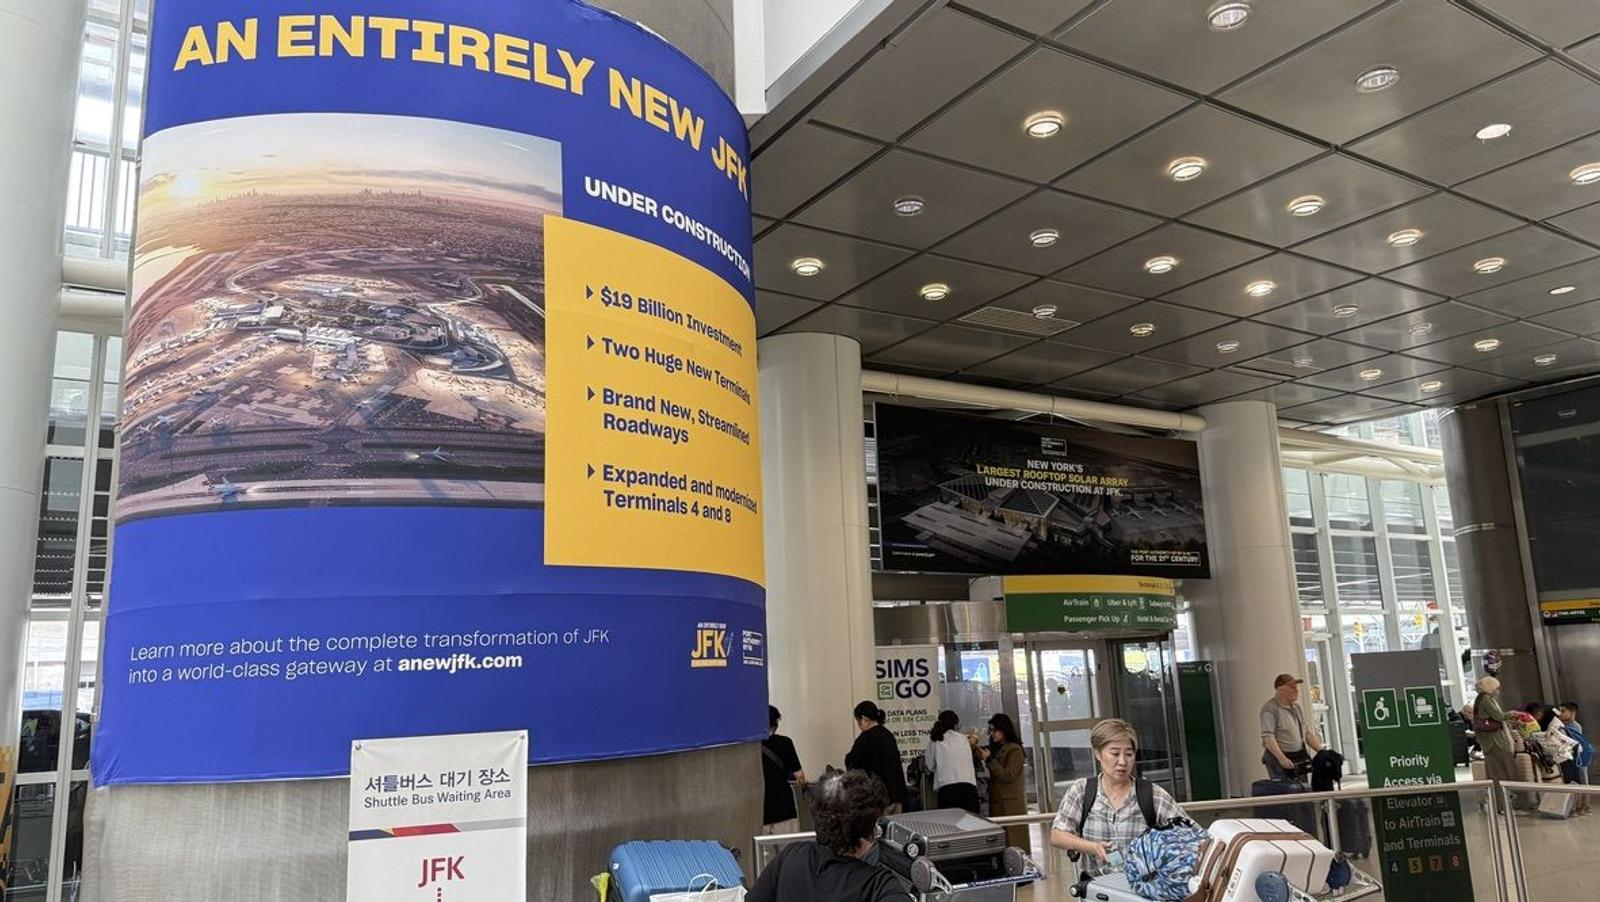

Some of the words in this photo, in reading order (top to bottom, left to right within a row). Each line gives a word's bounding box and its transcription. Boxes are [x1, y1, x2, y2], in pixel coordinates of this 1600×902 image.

[173, 17, 258, 71] AN
[277, 14, 595, 96] ENTIRELY
[608, 67, 705, 151] NEW
[711, 135, 748, 202] JFK
[584, 176, 659, 217] UNDER
[661, 205, 751, 282] CONSTRUCTION
[600, 285, 633, 309] $19
[638, 297, 684, 326] Billion
[686, 313, 743, 357] Investment
[602, 337, 640, 360] Two
[645, 347, 683, 373] Huge
[687, 358, 714, 382] New
[714, 370, 751, 405] Terminals
[603, 388, 656, 412] Brand
[660, 398, 696, 424] New,
[603, 412, 689, 445] Roadways
[976, 463, 1022, 479] LARGEST
[1023, 469, 1067, 482] ROOFTOP
[1068, 473, 1098, 485] SOLAR
[1099, 476, 1129, 487] ARRAY
[1026, 459, 1049, 470] NEW
[1050, 462, 1084, 473] YORK'S
[603, 463, 687, 491] Expanded
[691, 480, 713, 496] and
[984, 477, 1020, 489] UNDER
[1020, 480, 1092, 495] CONSTRUCTION
[1093, 486, 1105, 495] AT
[1106, 488, 1124, 497] JFK.
[603, 489, 688, 515] Terminals
[690, 500, 699, 516] 4
[702, 505, 723, 521] and
[724, 508, 732, 523] 8
[1130, 553, 1145, 562] FOR
[1145, 554, 1157, 562] THE
[1170, 555, 1199, 563] CENTURY
[1063, 598, 1090, 606] AirTrain
[1063, 615, 1098, 624] Passenger
[130, 643, 175, 662] Learn
[179, 641, 224, 658] more
[229, 637, 283, 655] about
[289, 635, 320, 652] the
[326, 632, 418, 655] complete
[424, 629, 558, 649] transformation
[563, 628, 579, 645] of
[583, 628, 610, 645] JFK
[691, 629, 727, 659] JFK
[128, 667, 158, 684] into
[162, 669, 173, 682] a
[177, 661, 280, 681] world-class
[285, 658, 368, 681] gateway
[373, 656, 393, 673] at
[398, 653, 523, 674] anewjfk.com
[876, 658, 930, 679] SIMS
[895, 678, 931, 699] GO
[887, 709, 905, 717] DATA
[905, 708, 928, 716] PLANS
[1389, 754, 1430, 768] Priority
[364, 773, 434, 793] 셔틀버스
[439, 769, 473, 788] 대기
[478, 766, 512, 786] 장소
[1384, 776, 1425, 788] Access
[1426, 773, 1442, 785] via
[364, 795, 409, 809] Shuttle
[411, 793, 434, 805] Bus
[436, 789, 481, 803] Waiting
[483, 787, 511, 800] Area
[1386, 795, 1432, 809] Elevator
[1384, 818, 1397, 831] to
[1399, 813, 1441, 830] AirTrain
[1383, 838, 1405, 853] and
[1406, 832, 1461, 849] Terminals
[417, 855, 466, 888] JFK
[1391, 861, 1399, 873] 4
[1411, 859, 1420, 872] 5
[1431, 858, 1439, 869] 7
[1451, 855, 1460, 867] 8
